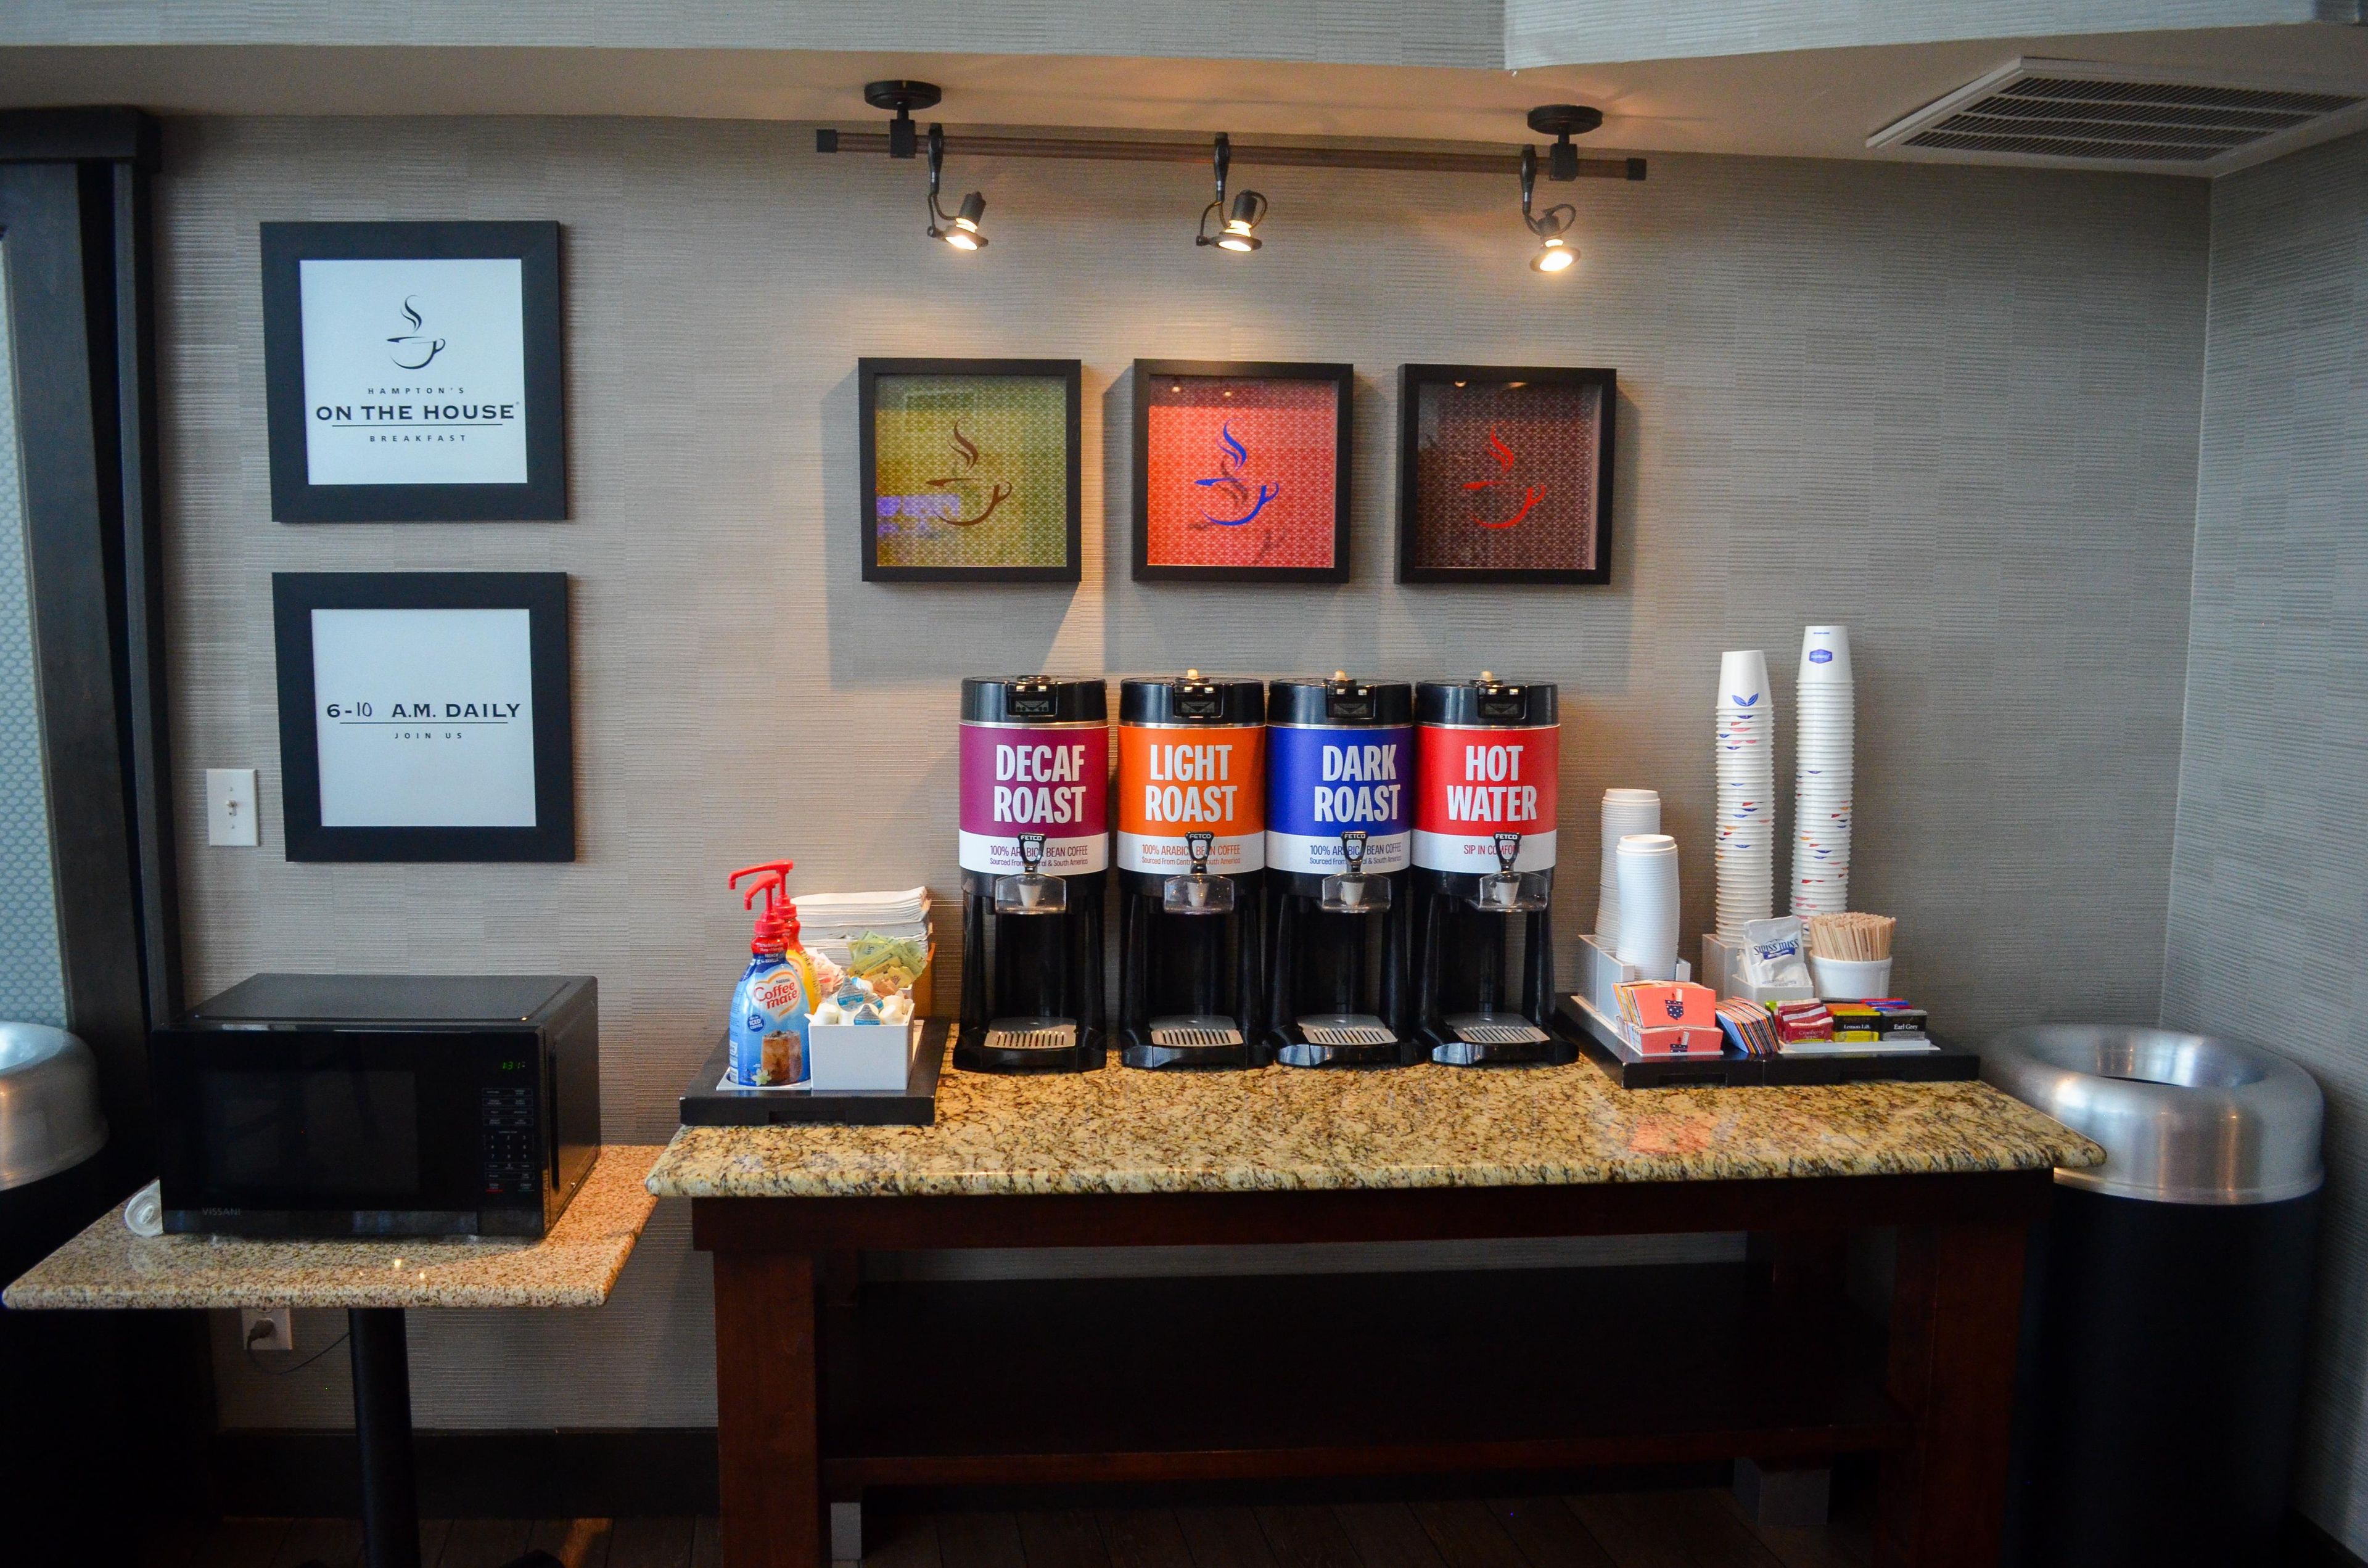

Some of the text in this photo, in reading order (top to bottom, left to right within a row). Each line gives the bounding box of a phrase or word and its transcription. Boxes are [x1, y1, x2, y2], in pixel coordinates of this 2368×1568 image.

[368, 387, 465, 395] HAMPTON'S
[316, 404, 515, 421] ON THE HOUSE
[327, 702, 521, 718] 6-10 A.M. DAILY
[996, 744, 1085, 782] DECAF
[1149, 744, 1233, 782] LIGHT
[1322, 744, 1397, 782] DARK
[1465, 745, 1523, 782] HOT
[993, 786, 1087, 823] ROAST
[1145, 785, 1238, 823] ROAST
[1314, 784, 1400, 823] ROAST
[1447, 786, 1537, 821] WATER
[990, 845, 1088, 857] 100% ARBIC BEAN COFFEE
[1142, 844, 1241, 856] 100% ARABIC BEN COFFEE
[1310, 842, 1402, 856] 100% ARBIC BEAN COFFEE
[1463, 844, 1476, 855] SIP
[1478, 845, 1486, 855] IN
[990, 858, 1011, 866] Sourced
[1054, 859, 1069, 867] South
[1141, 856, 1161, 864] Sourced
[754, 982, 795, 1002] Coffee
[766, 990, 798, 1009] mate
[202, 1207, 240, 1216] VISSANI
